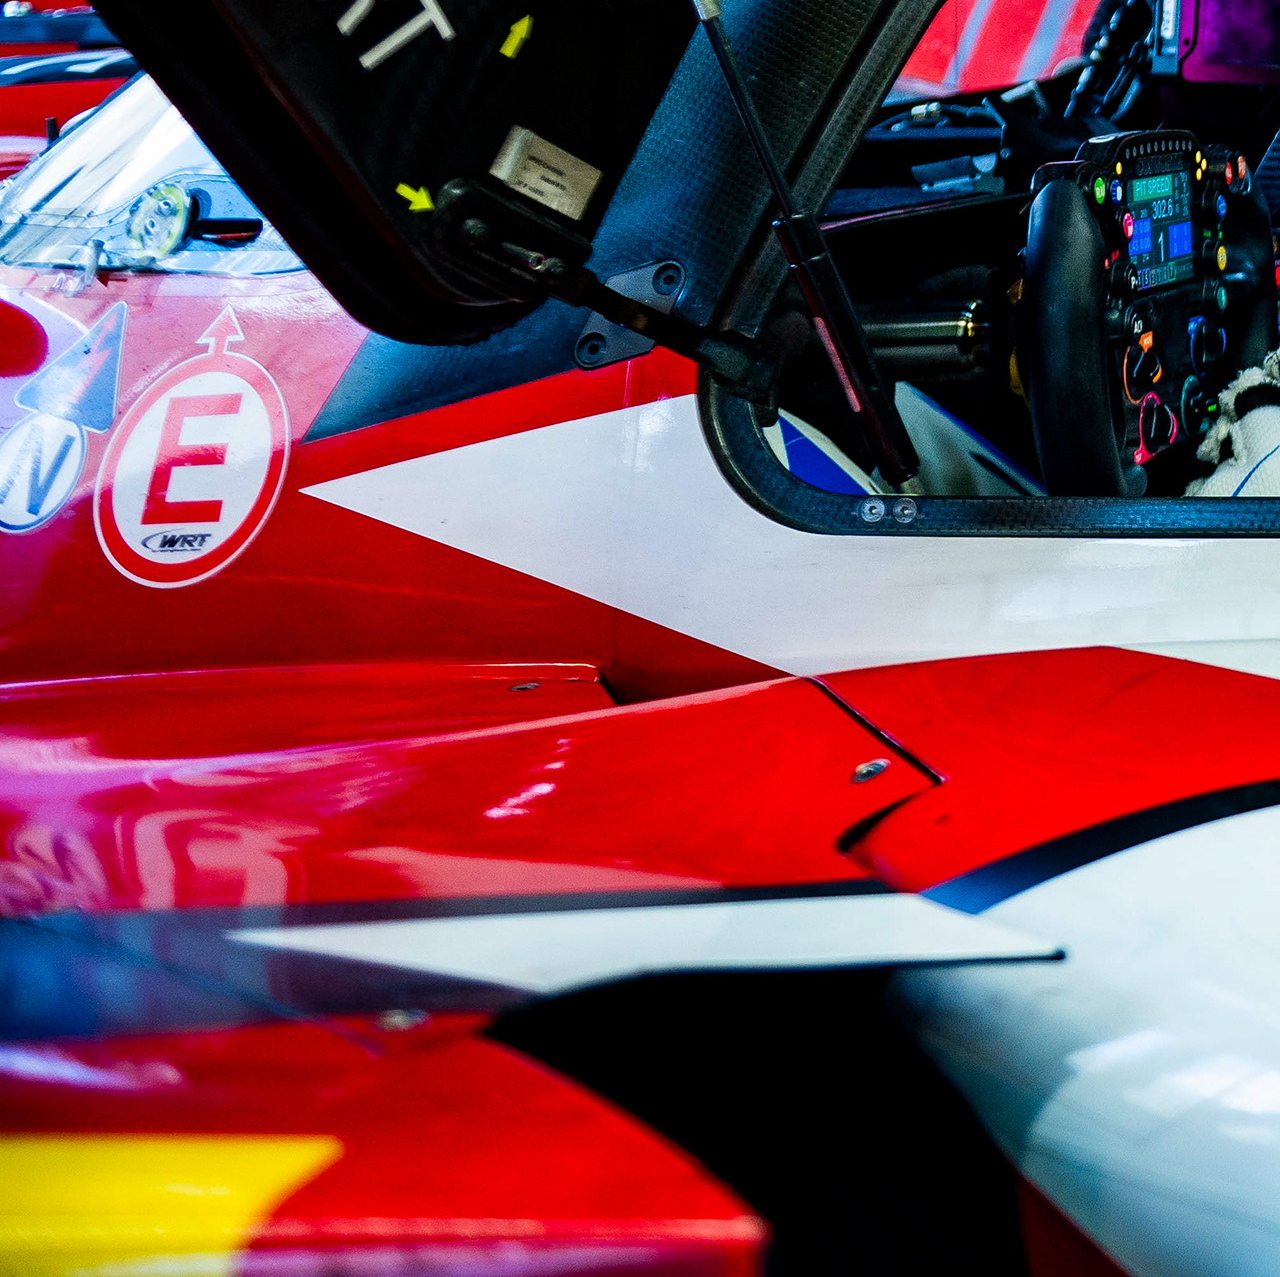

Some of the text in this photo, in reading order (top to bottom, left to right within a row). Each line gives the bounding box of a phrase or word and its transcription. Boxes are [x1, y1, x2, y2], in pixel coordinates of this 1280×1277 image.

[1147, 176, 1171, 195] SPEED
[1151, 197, 1174, 220] 302.6
[1157, 230, 1165, 263] 1
[140, 392, 243, 525] E
[158, 532, 213, 549] WRT
